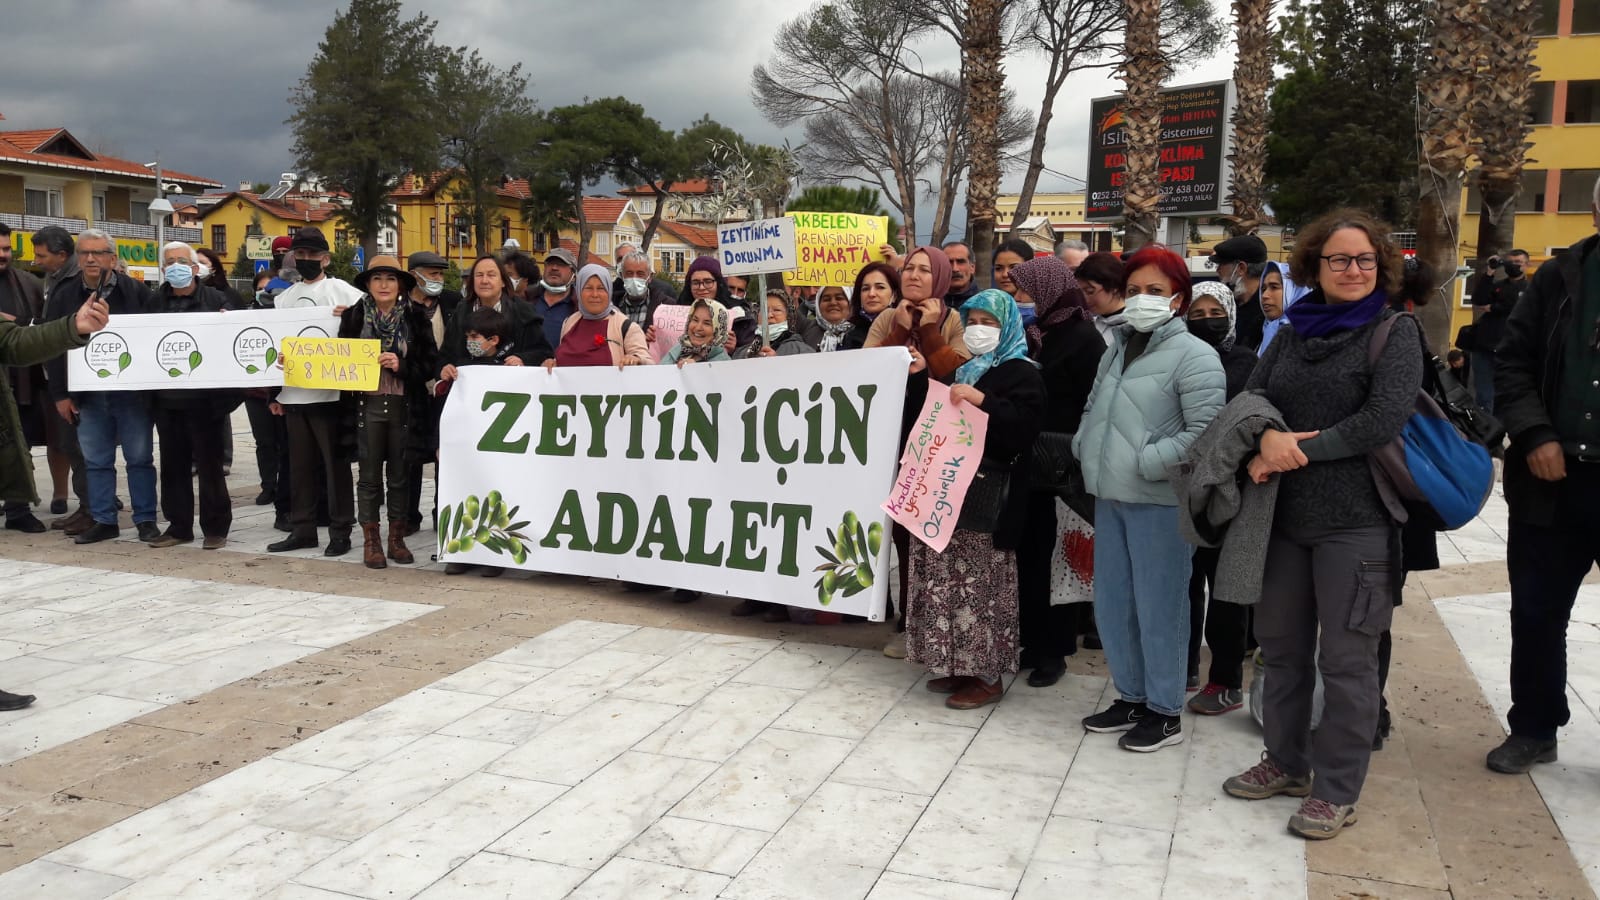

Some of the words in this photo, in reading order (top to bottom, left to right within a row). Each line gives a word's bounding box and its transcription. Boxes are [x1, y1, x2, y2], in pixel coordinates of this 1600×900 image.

[1162, 124, 1213, 139] sistemleri
[1091, 191, 1110, 200] 0252
[1176, 184, 1191, 194] 638
[1193, 183, 1215, 193] 0077
[793, 213, 858, 229] AKBELEN
[797, 230, 875, 247] İRENİŞİNDEN
[802, 246, 810, 263] 8
[834, 268, 857, 284] OLS
[656, 316, 684, 332] DİRE
[91, 342, 122, 355] İZÇEP
[162, 341, 191, 354] İZÇEP
[239, 337, 268, 351] İZÇEP
[287, 340, 351, 357] YAŞASIN
[303, 361, 313, 380] 8
[321, 361, 371, 382] MART
[907, 400, 944, 463] Zeytine
[539, 489, 813, 578] ADALET
